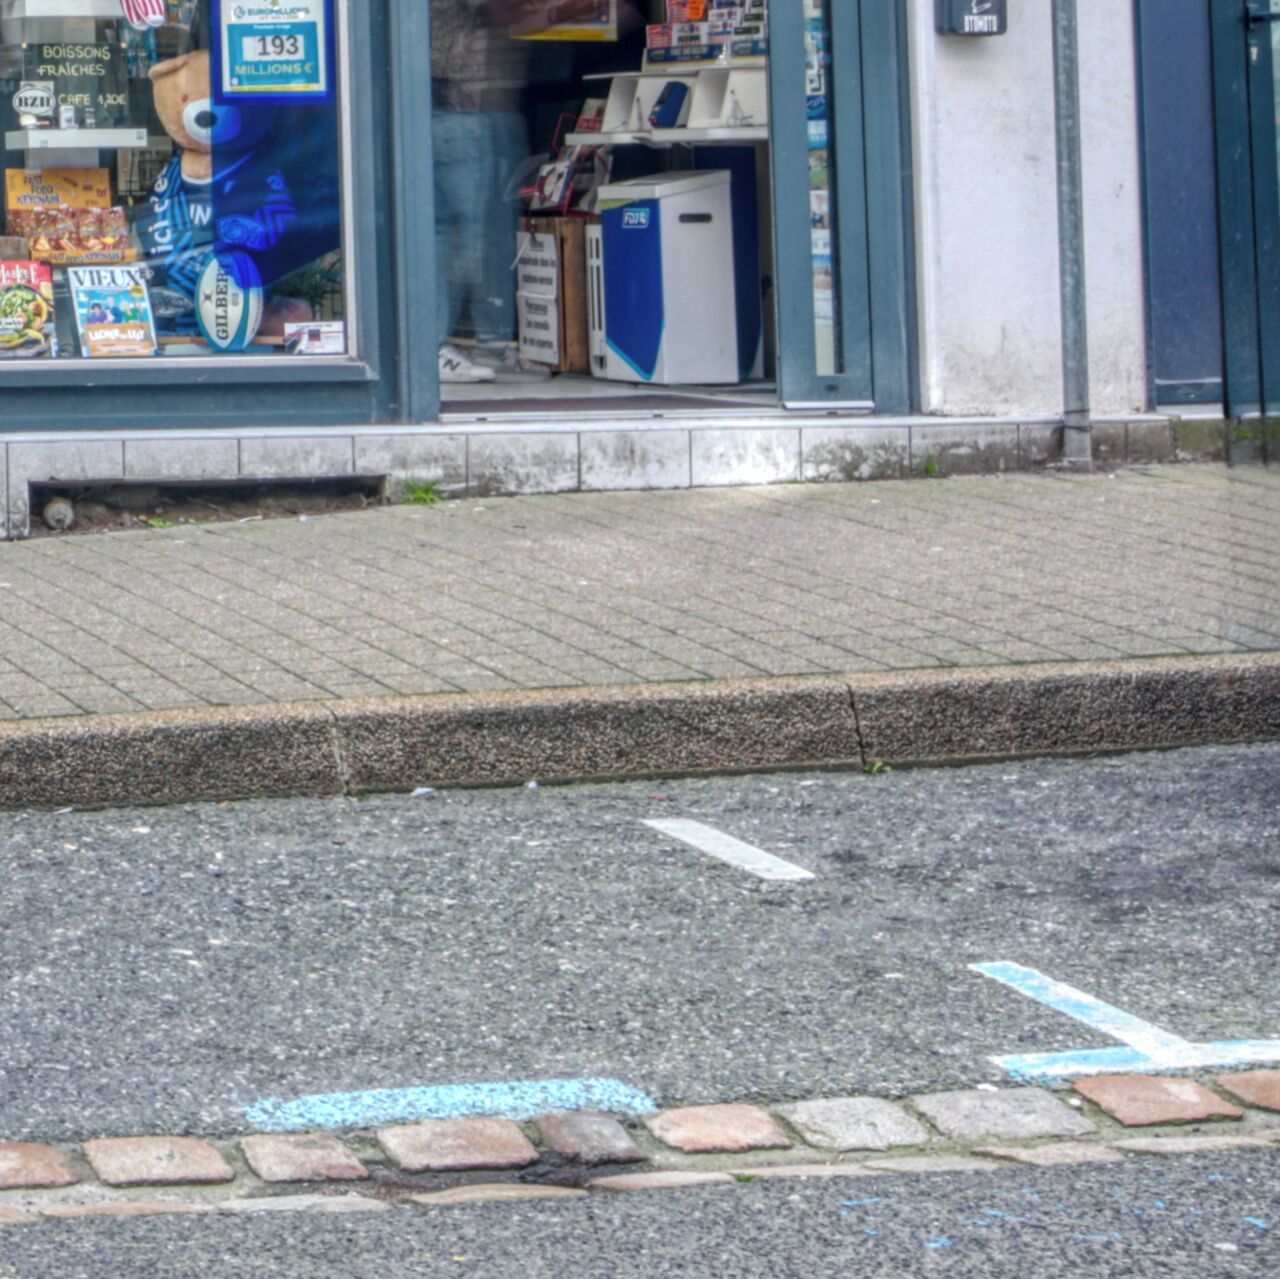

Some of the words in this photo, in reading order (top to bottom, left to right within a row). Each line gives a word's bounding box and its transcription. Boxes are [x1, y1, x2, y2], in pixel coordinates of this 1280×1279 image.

[257, 35, 299, 56] 193
[235, 63, 302, 75] MILLIONS
[18, 95, 51, 108] BZH
[72, 269, 142, 288] VIEUX
